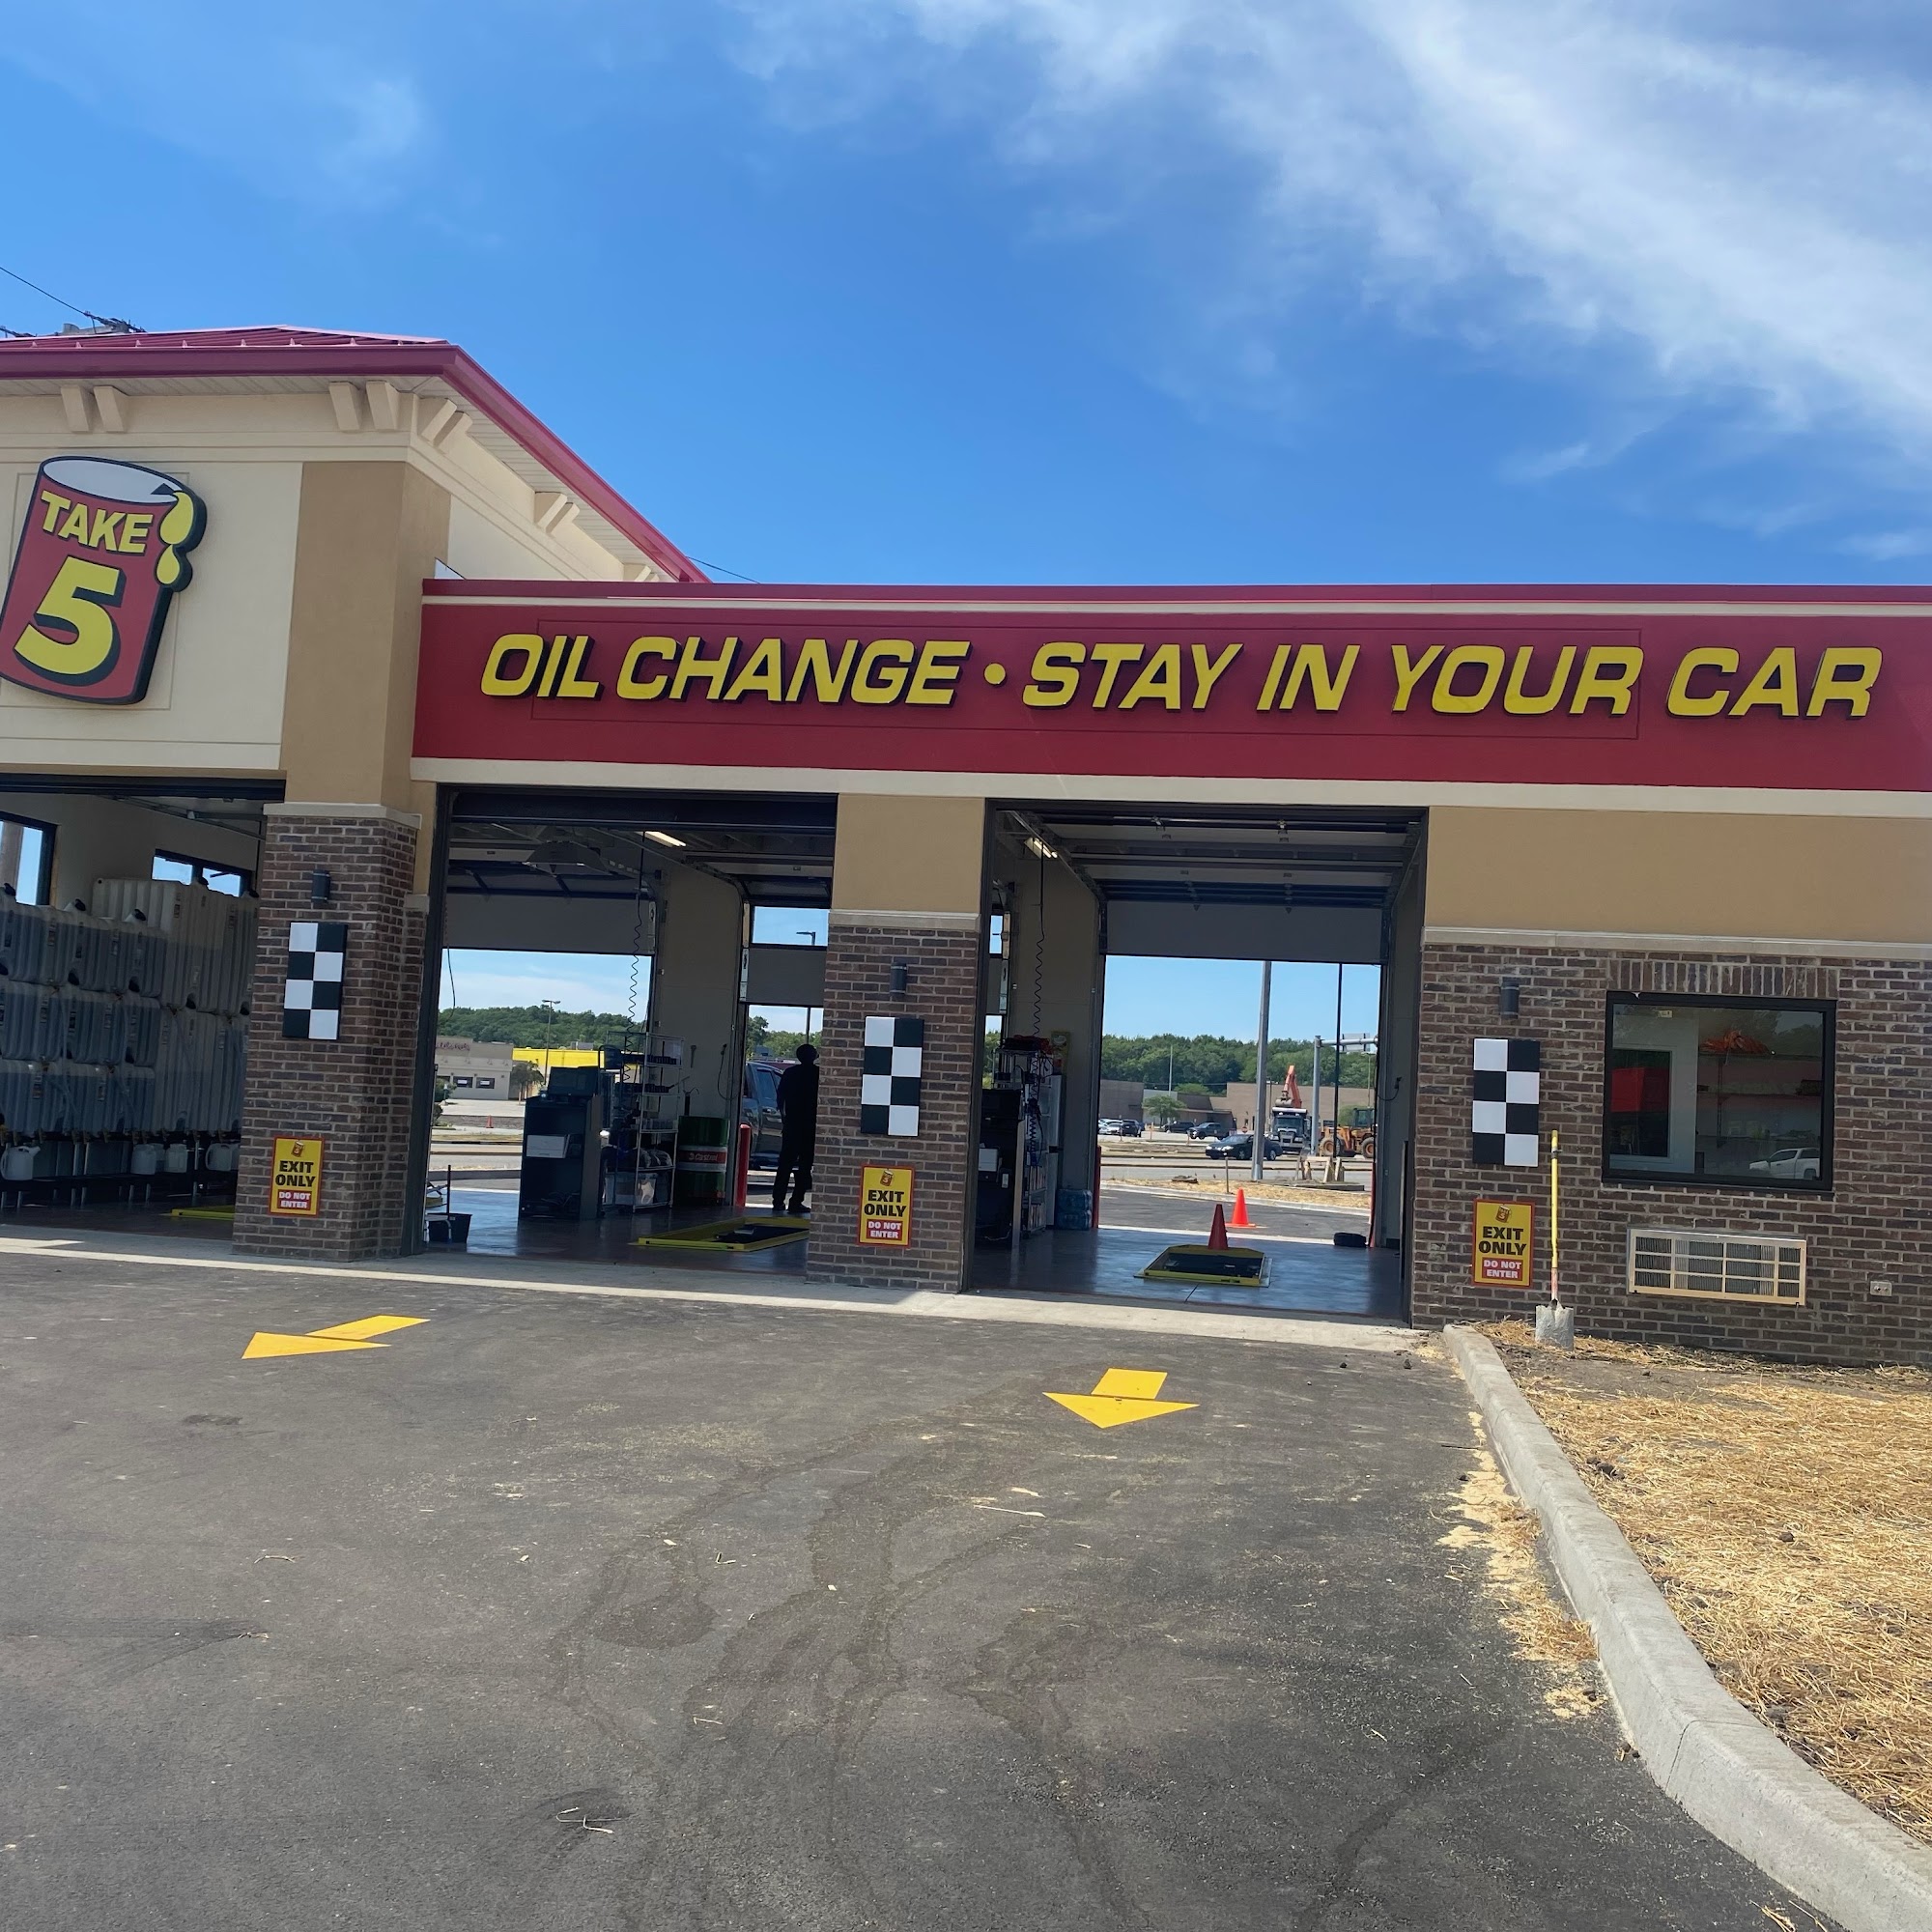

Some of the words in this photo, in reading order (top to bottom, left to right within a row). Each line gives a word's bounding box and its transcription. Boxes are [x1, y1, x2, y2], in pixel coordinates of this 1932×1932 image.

[40, 490, 155, 554] TAKE
[14, 555, 123, 676] 5
[480, 633, 601, 699] OIL
[616, 636, 972, 706] CHANGE
[1022, 640, 1244, 710] STAY
[1257, 643, 1361, 712] IN
[1391, 643, 1645, 716] YOUR
[1666, 646, 1884, 718] CAR
[279, 1160, 314, 1173] EXIT
[275, 1174, 316, 1187] ONLY
[867, 1189, 904, 1203] EXIT
[280, 1200, 307, 1208] ENTER
[864, 1203, 907, 1217] ONLY
[870, 1230, 898, 1238] ENTER
[1482, 1226, 1523, 1240] EXIT
[1478, 1240, 1527, 1256] ONLY
[1500, 1261, 1522, 1269] NOT
[1486, 1268, 1518, 1278] ENTER
